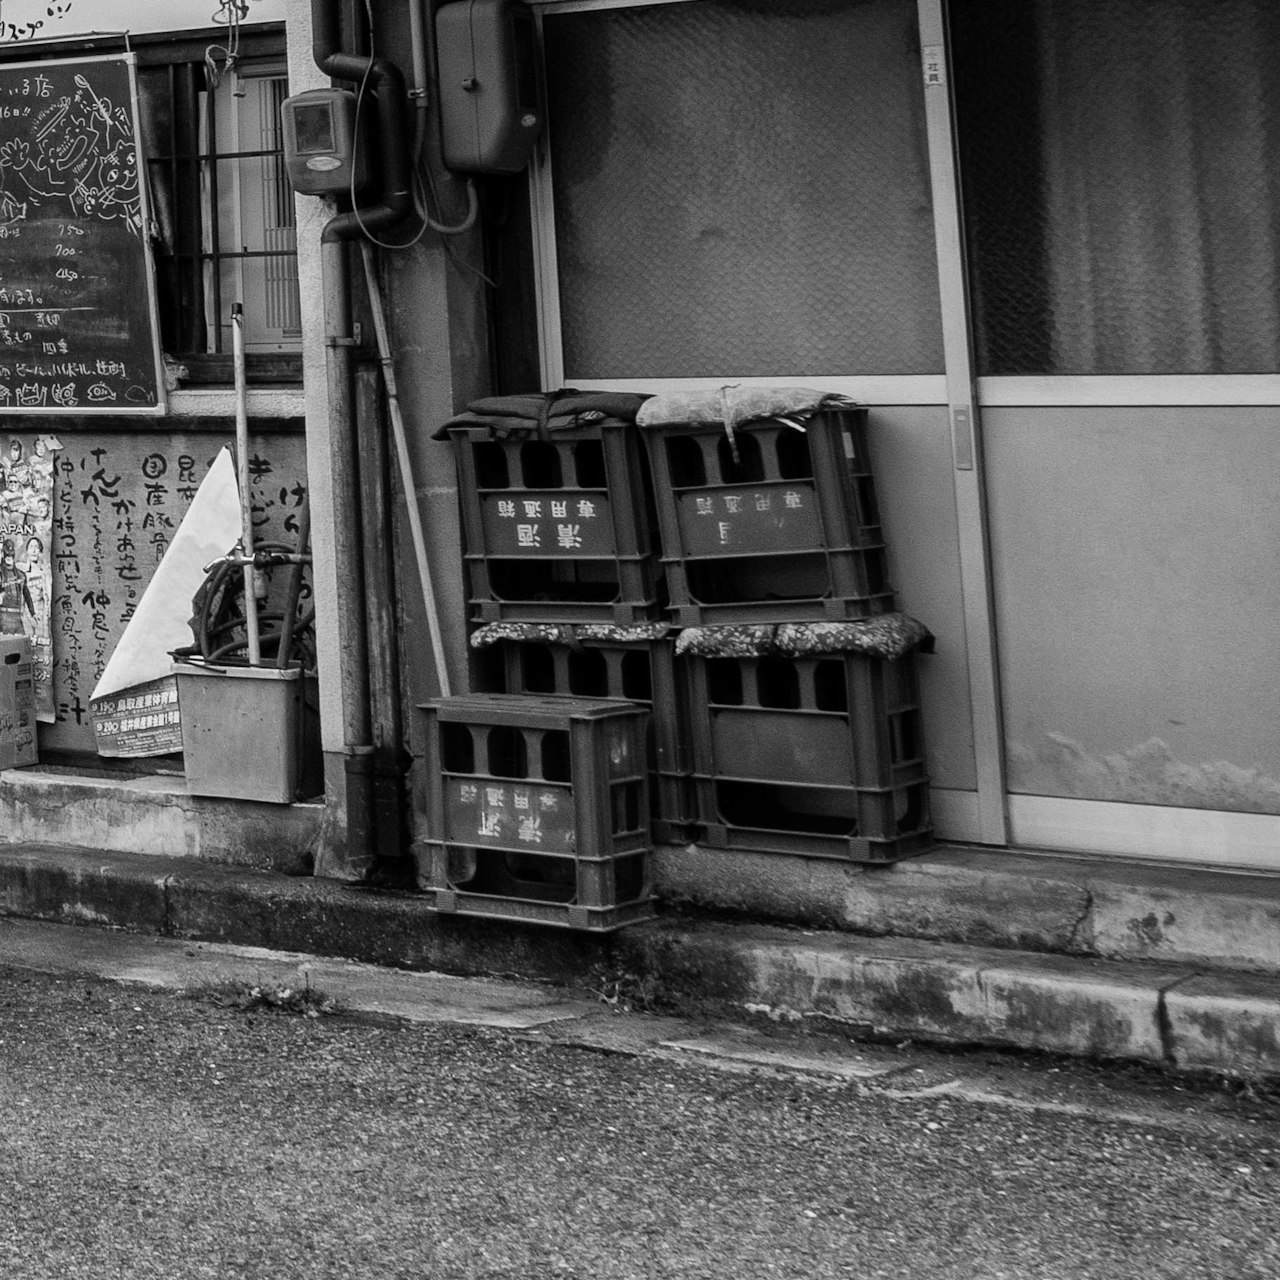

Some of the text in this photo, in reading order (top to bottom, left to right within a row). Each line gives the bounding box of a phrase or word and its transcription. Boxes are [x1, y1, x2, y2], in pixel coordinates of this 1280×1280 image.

[498, 499, 597, 519] 専用通箱
[516, 523, 584, 550] 清酒
